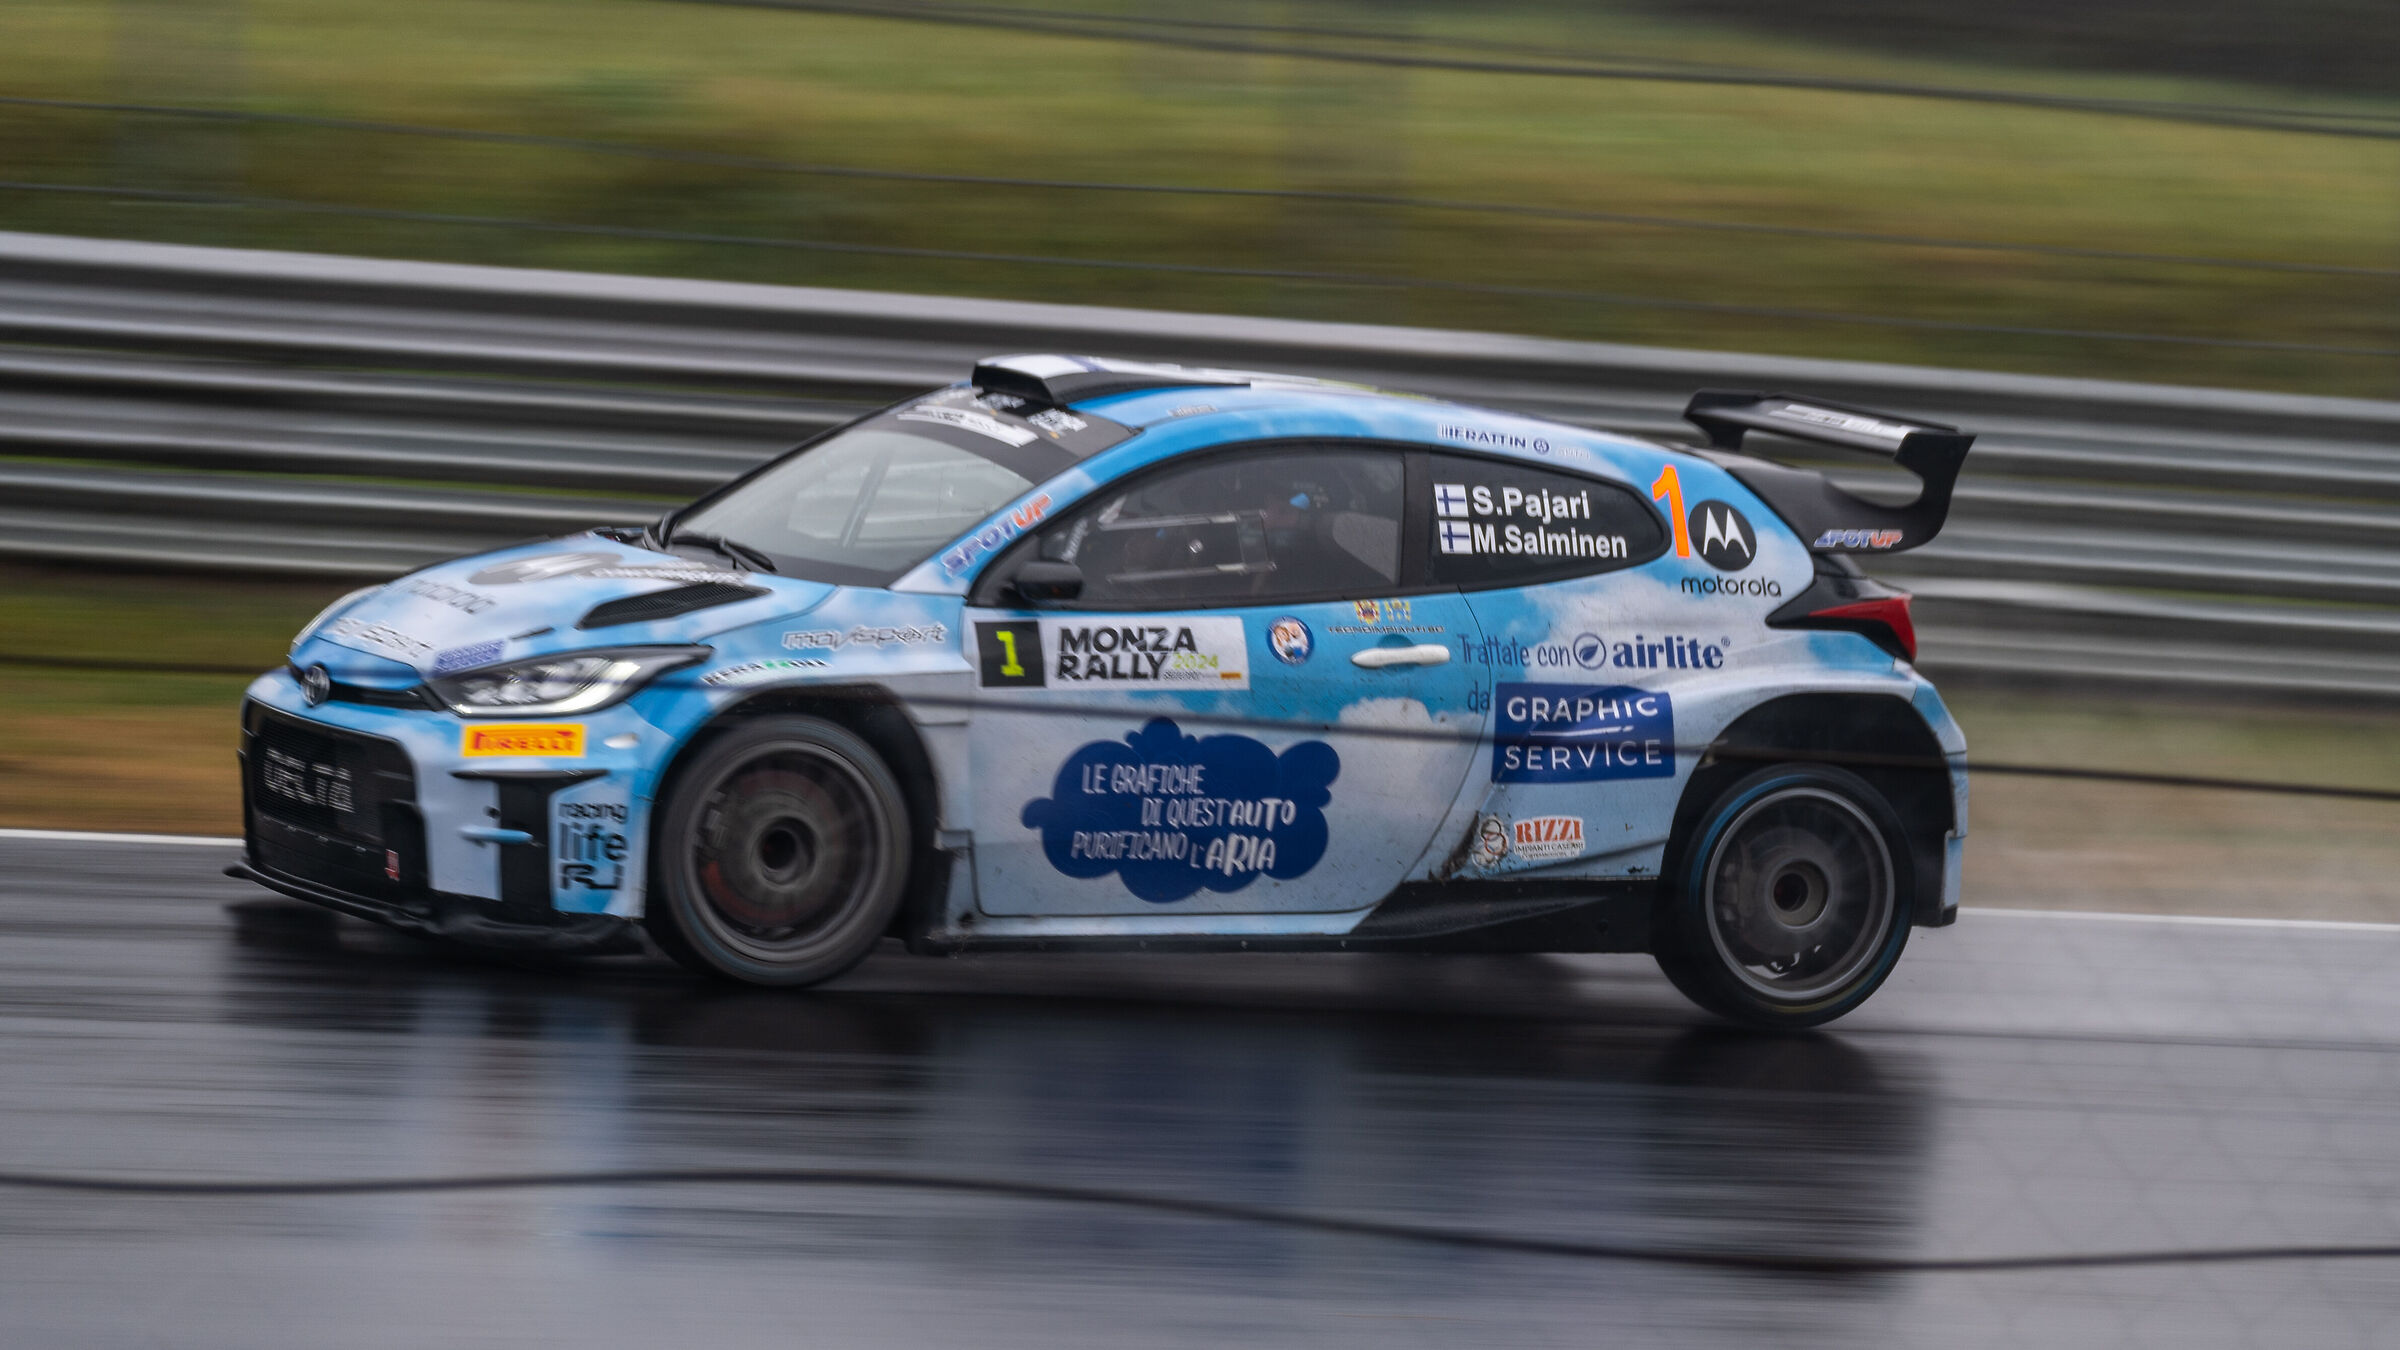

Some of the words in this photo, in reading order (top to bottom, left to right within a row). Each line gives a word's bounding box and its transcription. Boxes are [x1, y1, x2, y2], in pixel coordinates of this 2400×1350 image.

[1472, 485, 1591, 524] S.Pajari
[1651, 463, 1691, 559] 1
[1473, 523, 1628, 558] M.Salminen
[1681, 575, 1782, 597] motorola
[996, 630, 1025, 677] 1
[1059, 626, 1199, 654] MONZA
[1457, 634, 1531, 667] Trattate
[1537, 646, 1571, 667] con
[1056, 652, 1168, 680] RALLY
[1172, 653, 1218, 669] 2024
[1467, 680, 1491, 713] da
[1506, 696, 1659, 723] GRAPHIC
[472, 729, 576, 751] PIRELLI
[1503, 738, 1663, 770] SERVICE
[1081, 763, 1108, 794] LE
[1110, 763, 1206, 795] GRAFICHE
[558, 802, 628, 824] racing
[1140, 797, 1165, 827] DI
[558, 821, 628, 862] life
[1070, 830, 1189, 860] PURIFICANO
[1515, 818, 1582, 843] RIZZI
